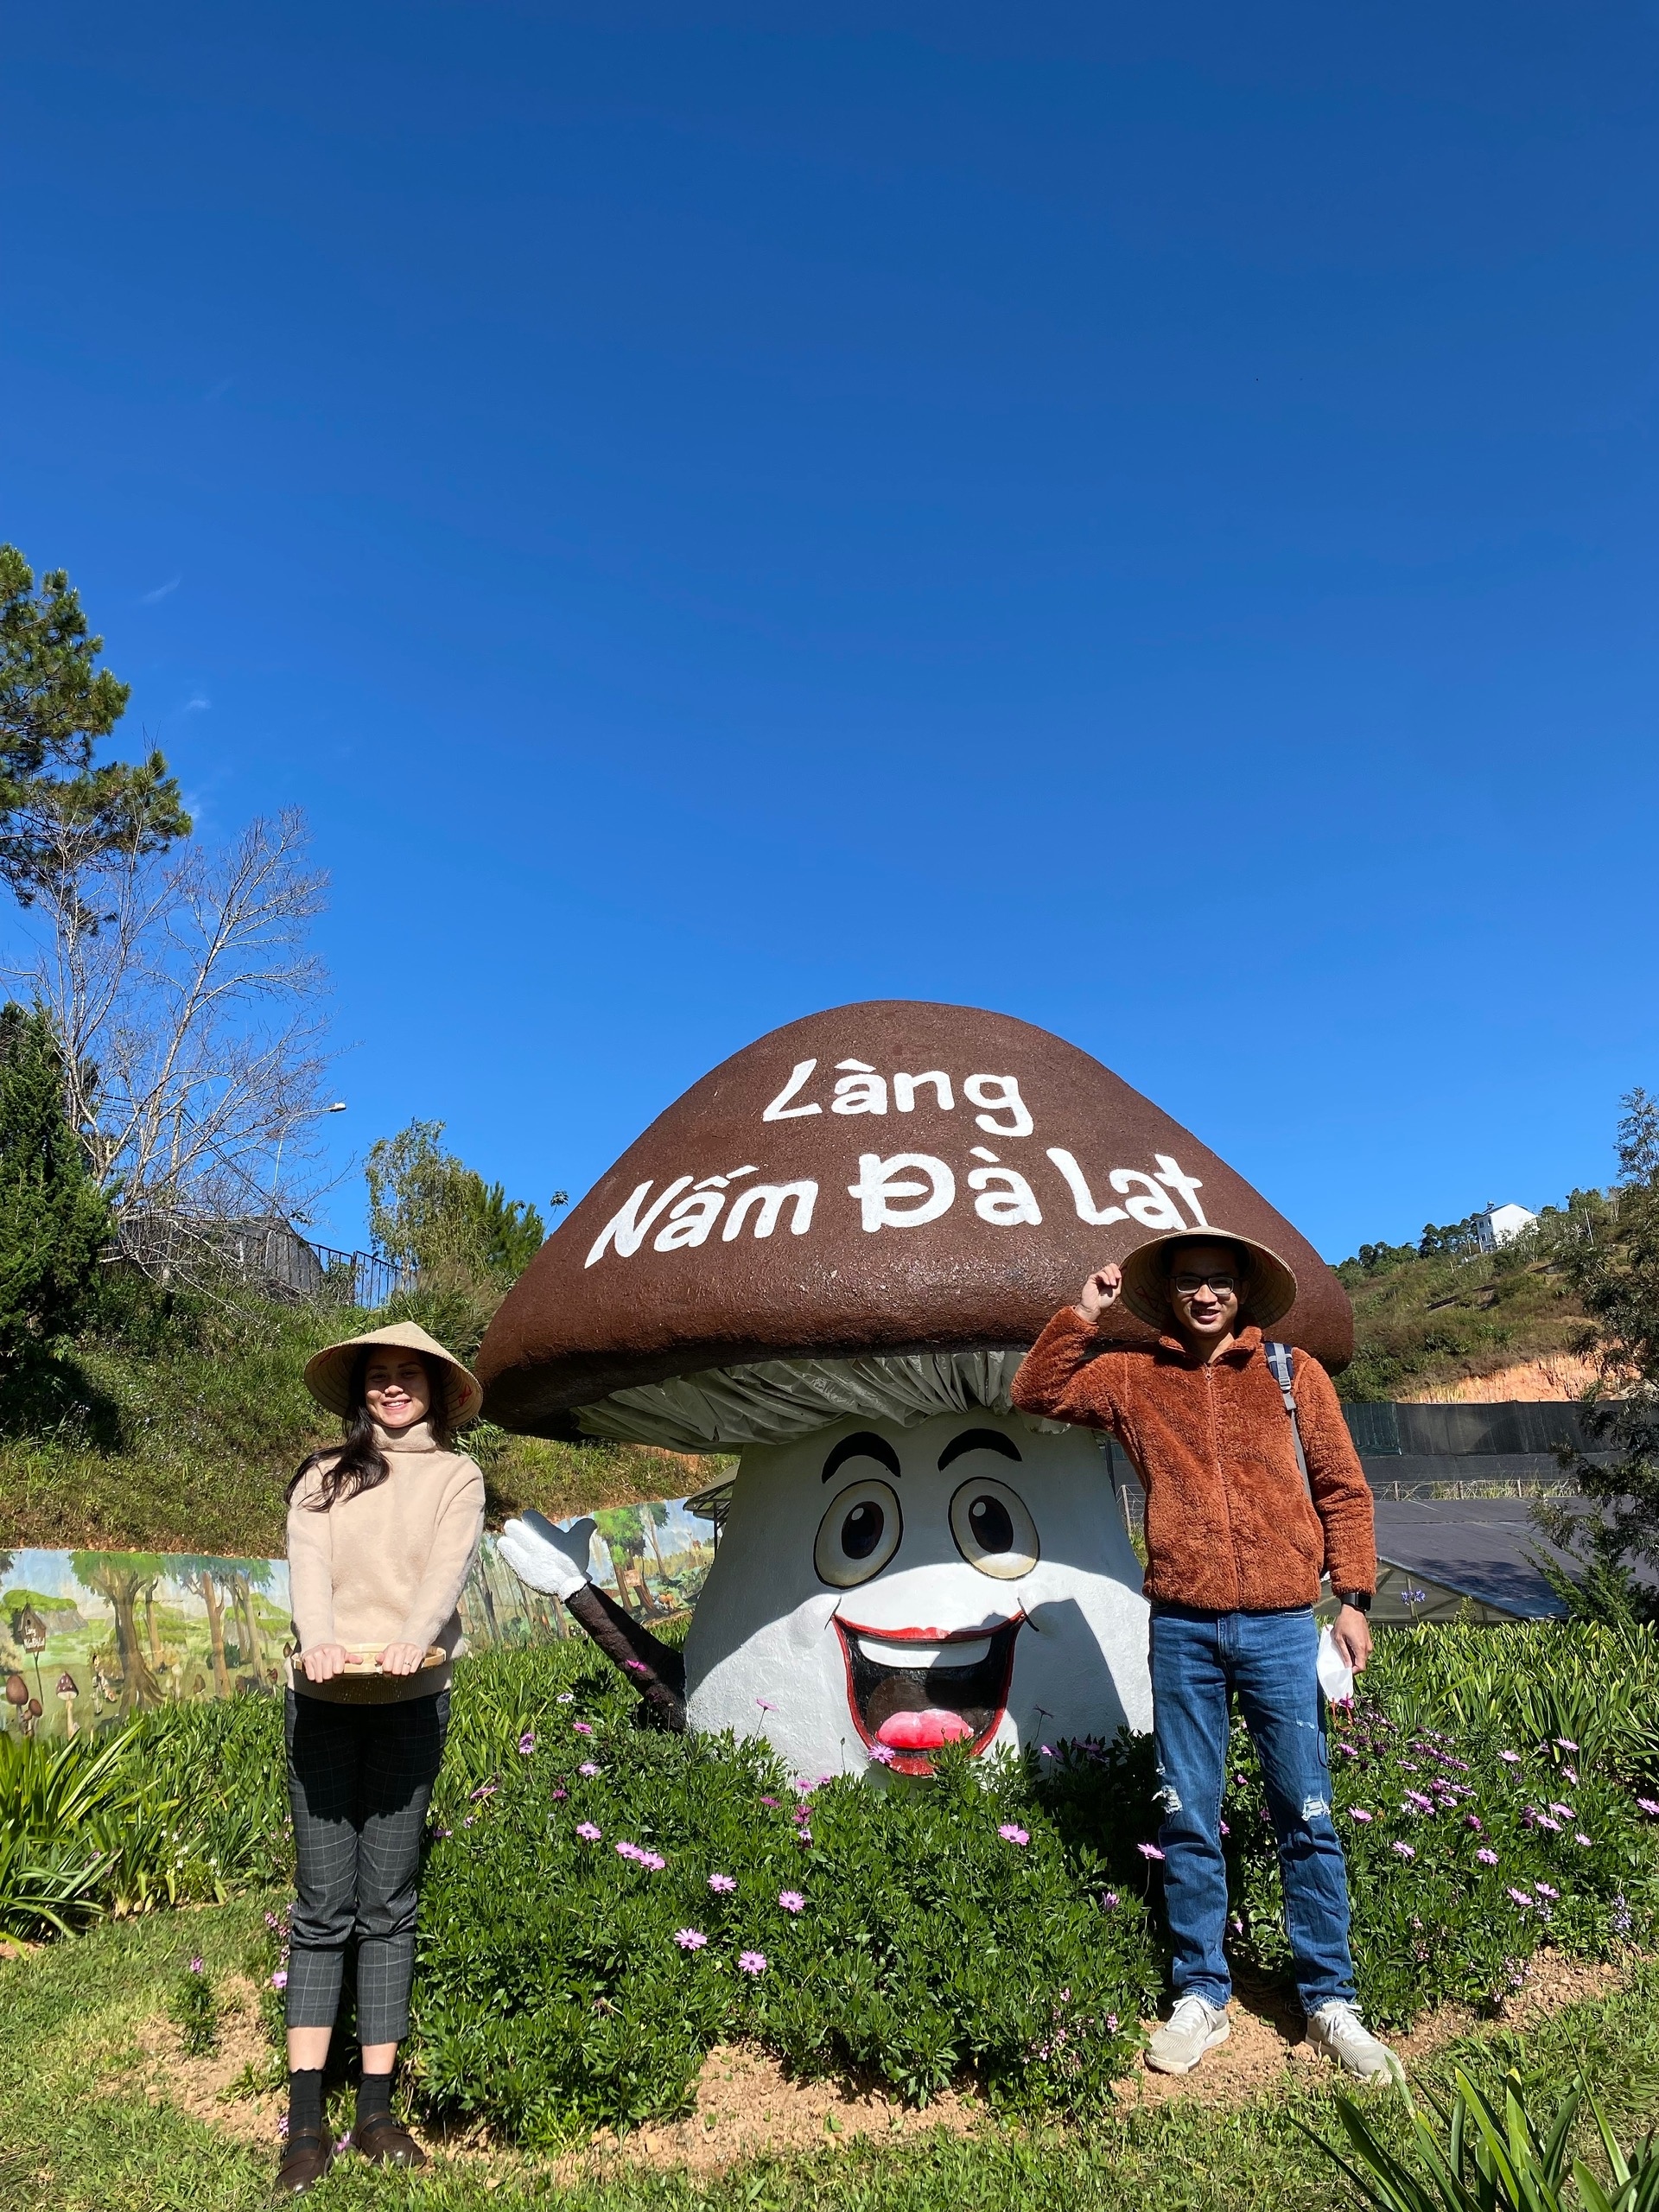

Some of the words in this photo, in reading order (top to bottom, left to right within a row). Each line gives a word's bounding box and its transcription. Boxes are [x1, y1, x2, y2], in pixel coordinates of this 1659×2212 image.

[763, 1058, 1033, 1137] Làng
[584, 1165, 818, 1268] Nấm
[848, 1146, 1043, 1233] Đà
